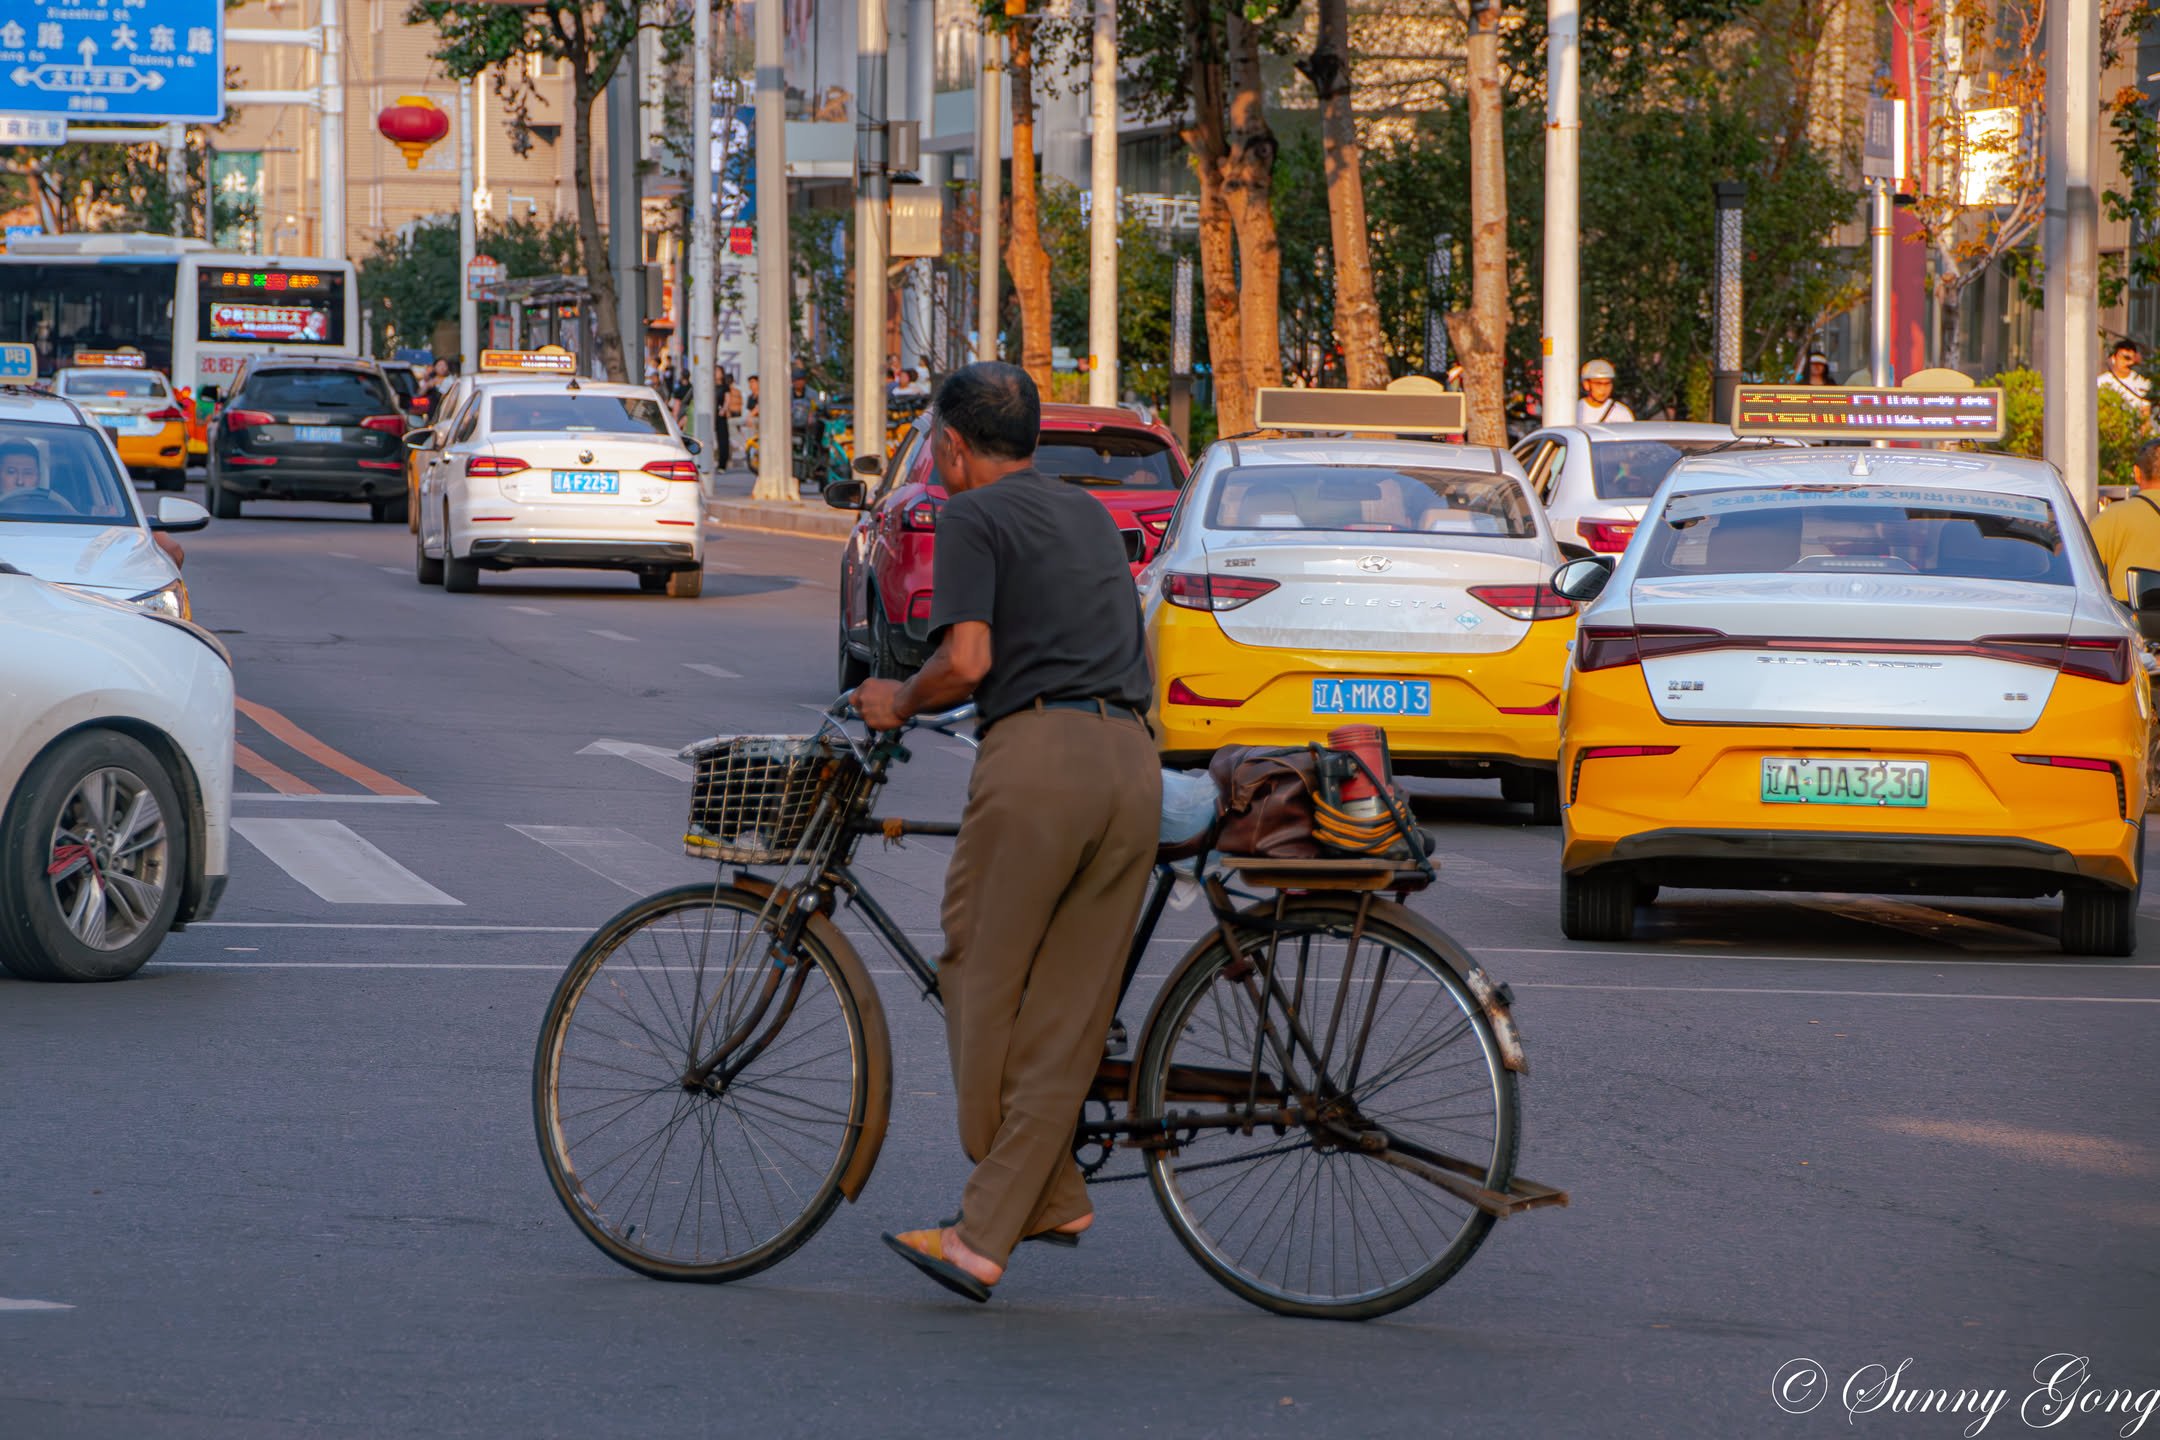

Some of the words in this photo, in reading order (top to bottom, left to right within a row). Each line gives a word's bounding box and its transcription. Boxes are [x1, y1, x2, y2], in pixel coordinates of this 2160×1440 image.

[111, 23, 214, 54] 大东路
[1299, 596, 1447, 610] CELESTA
